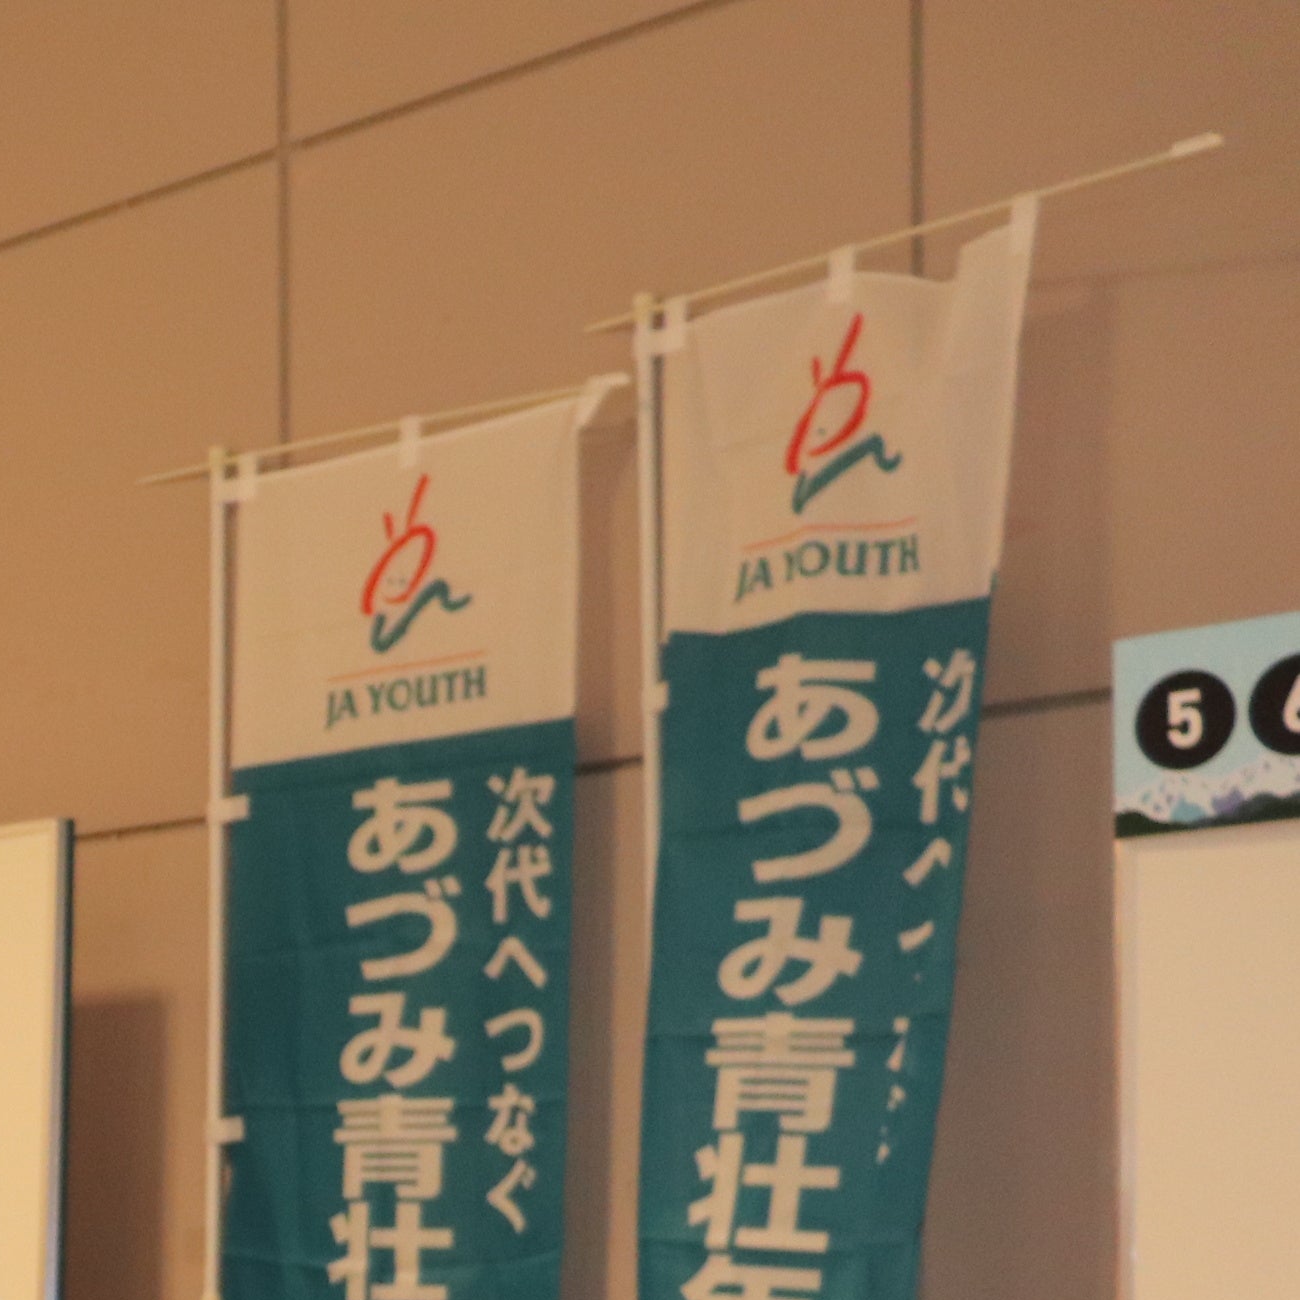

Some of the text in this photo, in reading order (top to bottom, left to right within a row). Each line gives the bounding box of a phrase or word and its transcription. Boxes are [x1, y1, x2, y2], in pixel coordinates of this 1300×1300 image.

[736, 556, 773, 601] JA
[323, 665, 489, 729] JA YOUTH
[1166, 686, 1204, 750] 5
[484, 767, 555, 1236] 次代へつなぐ
